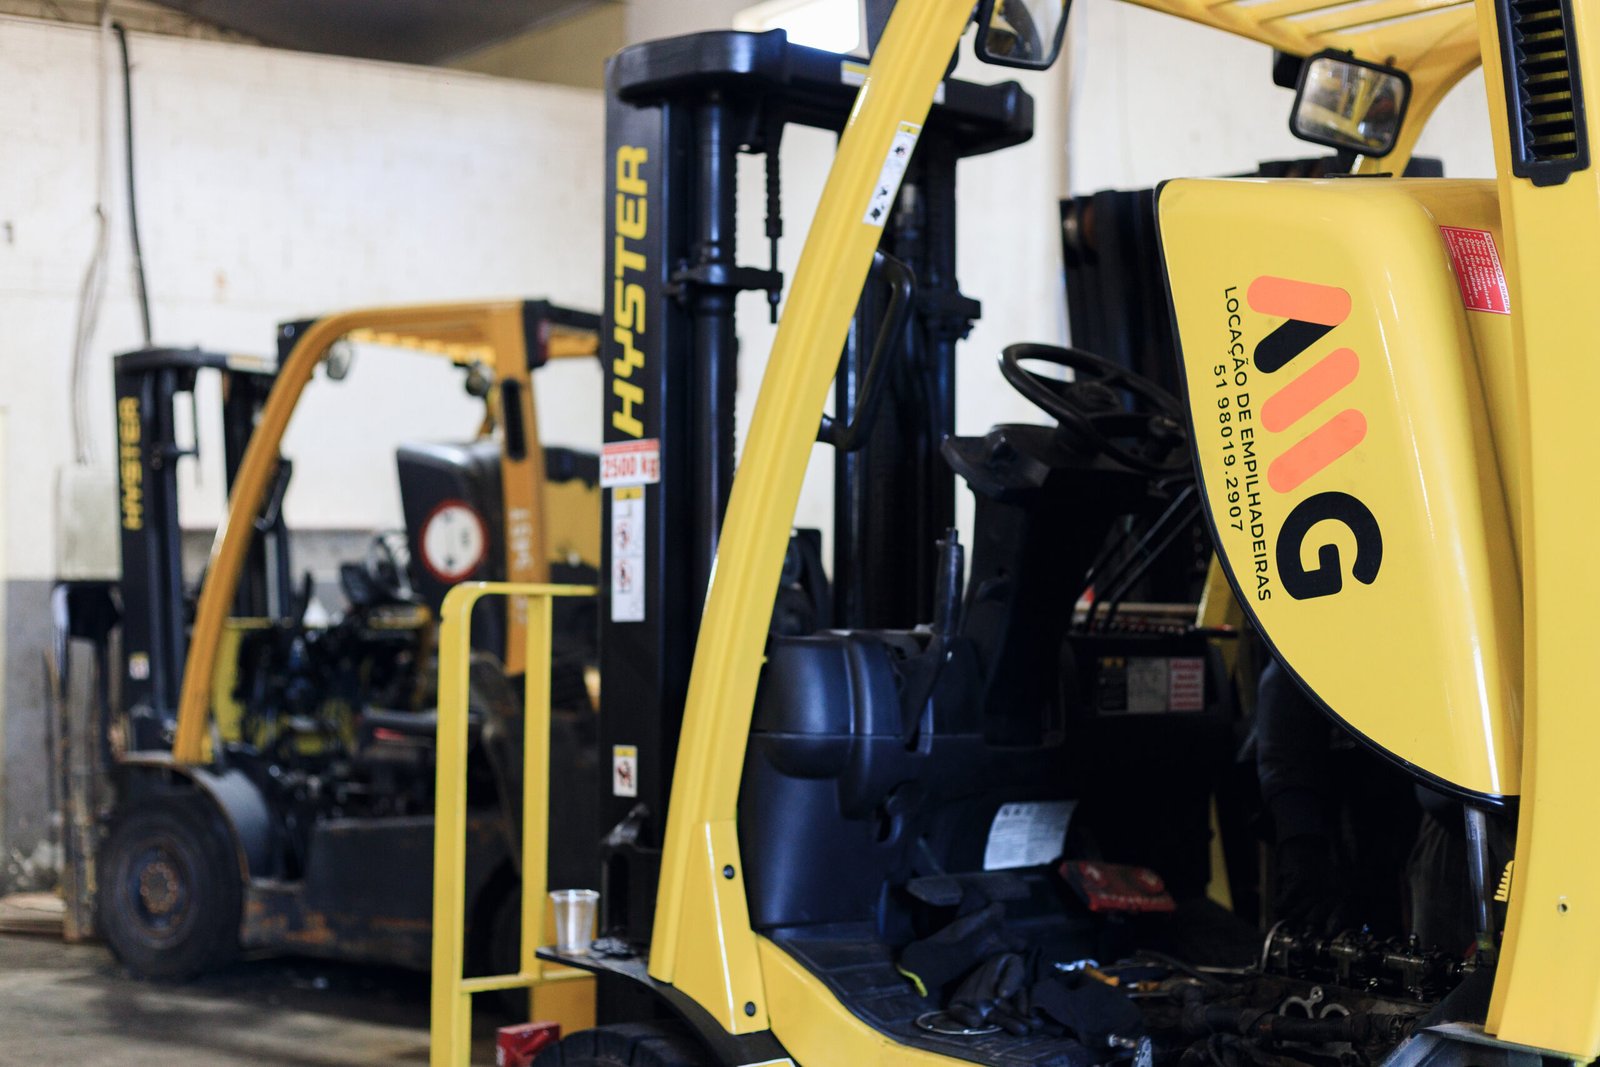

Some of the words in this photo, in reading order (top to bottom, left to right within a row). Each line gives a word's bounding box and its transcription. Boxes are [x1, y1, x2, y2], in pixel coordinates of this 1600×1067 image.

[613, 147, 647, 438] HYSTER
[1486, 234, 1503, 283] VERIFICAÇÃO
[1214, 365, 1227, 388] 51
[1225, 287, 1248, 387] LOCAÇÃO
[1237, 393, 1251, 422] DE
[1218, 397, 1243, 531] 98019.2907
[1241, 428, 1271, 600] EMPILHADEIRAS
